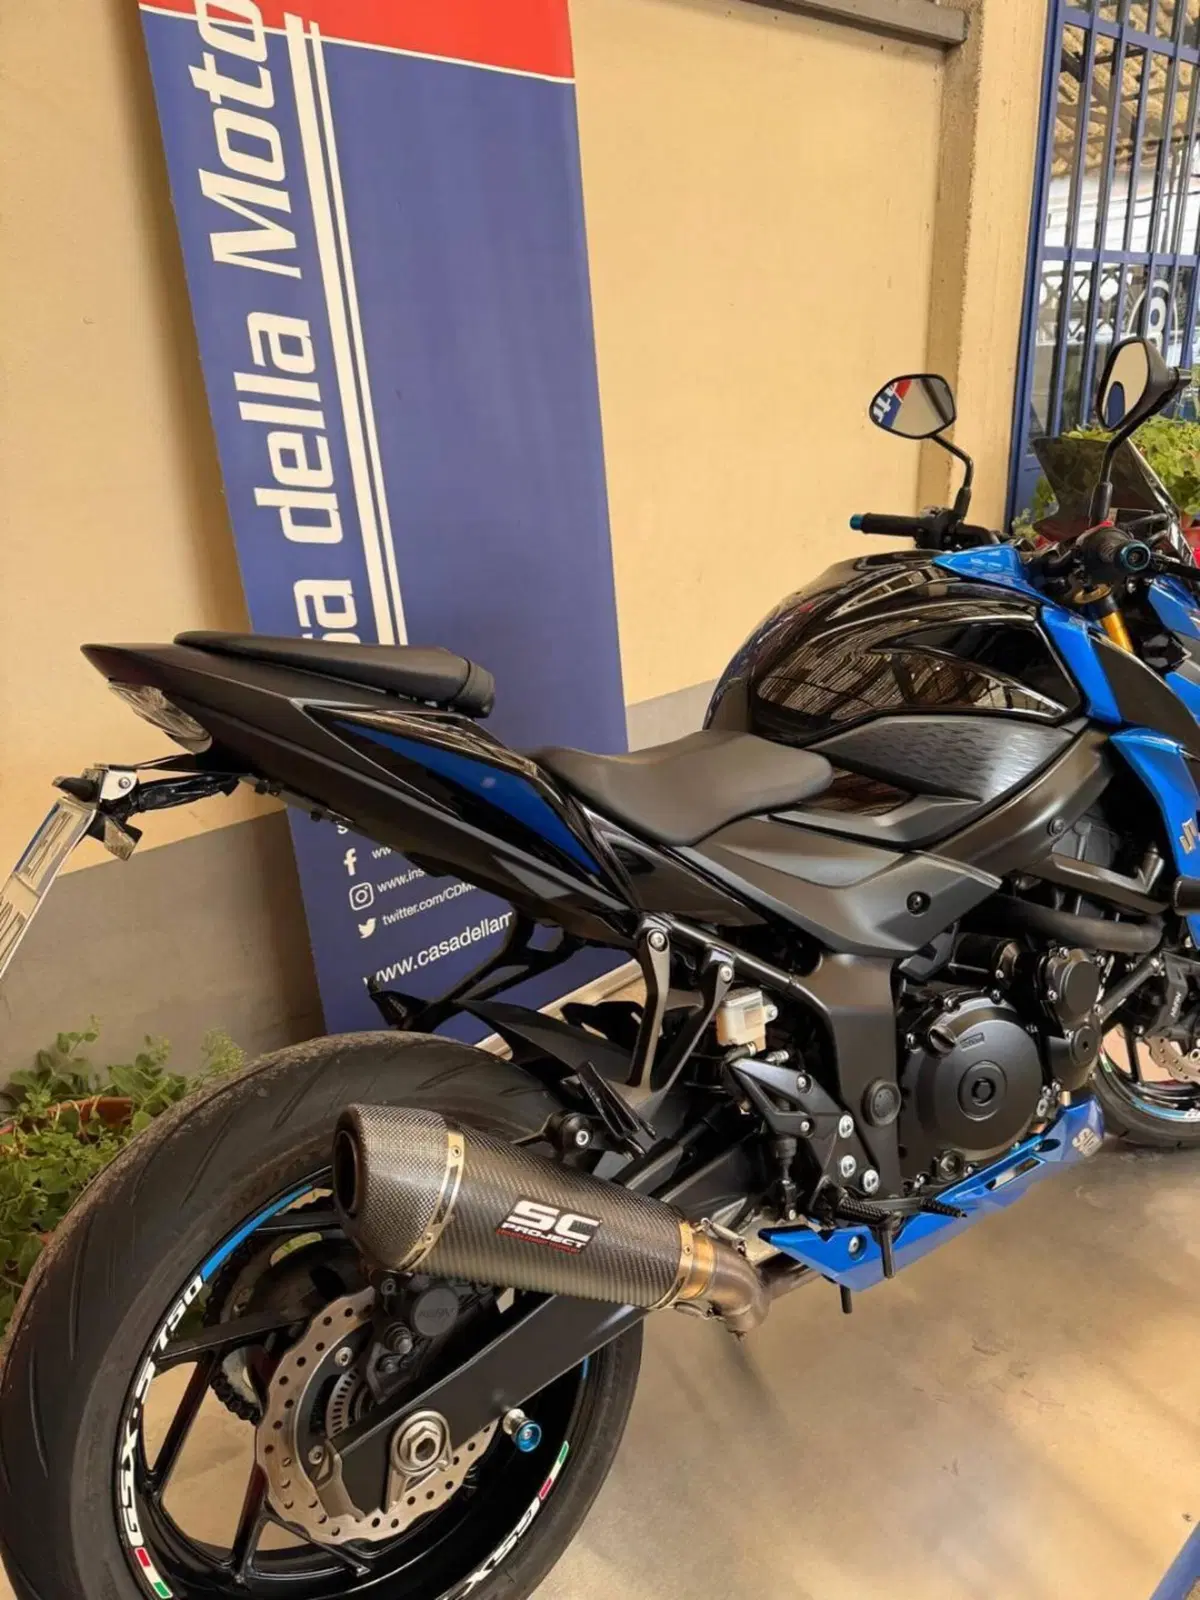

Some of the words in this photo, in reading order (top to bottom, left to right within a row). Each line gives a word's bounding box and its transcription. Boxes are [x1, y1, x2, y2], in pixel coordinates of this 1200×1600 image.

[188, 0, 302, 279] Moto
[234, 312, 343, 544] della
[293, 580, 361, 644] a
[382, 881, 478, 926] twitter.com/CDM
[501, 1222, 587, 1249] PROJECT
[507, 1199, 601, 1242] SC
